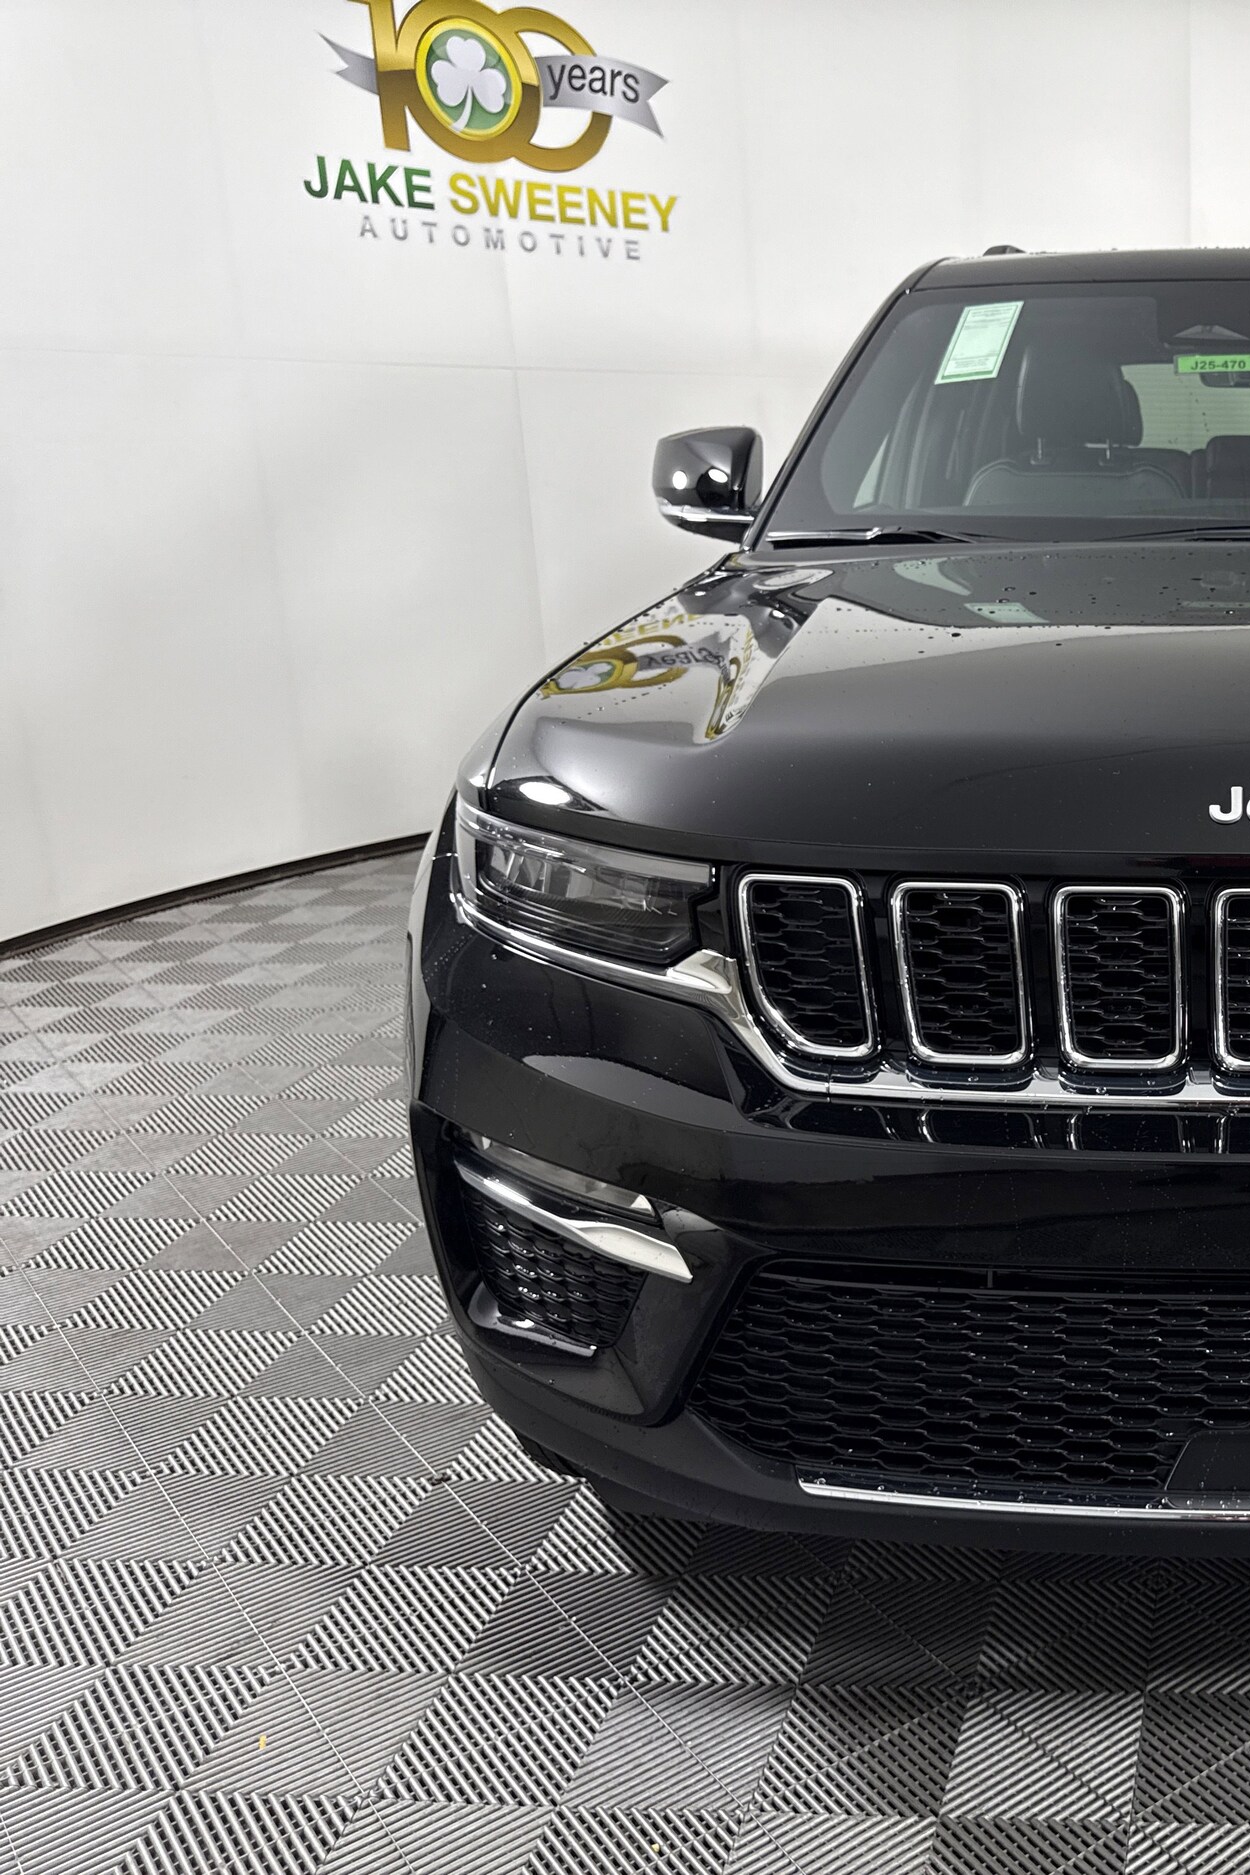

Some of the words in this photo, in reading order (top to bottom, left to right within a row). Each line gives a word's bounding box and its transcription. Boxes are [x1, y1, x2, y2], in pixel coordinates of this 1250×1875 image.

[547, 62, 642, 103] years
[303, 155, 436, 211] JAKE
[448, 172, 678, 233] SWEENEY
[358, 215, 642, 262] AUTOMOTIVE
[1190, 360, 1247, 371] J25-470
